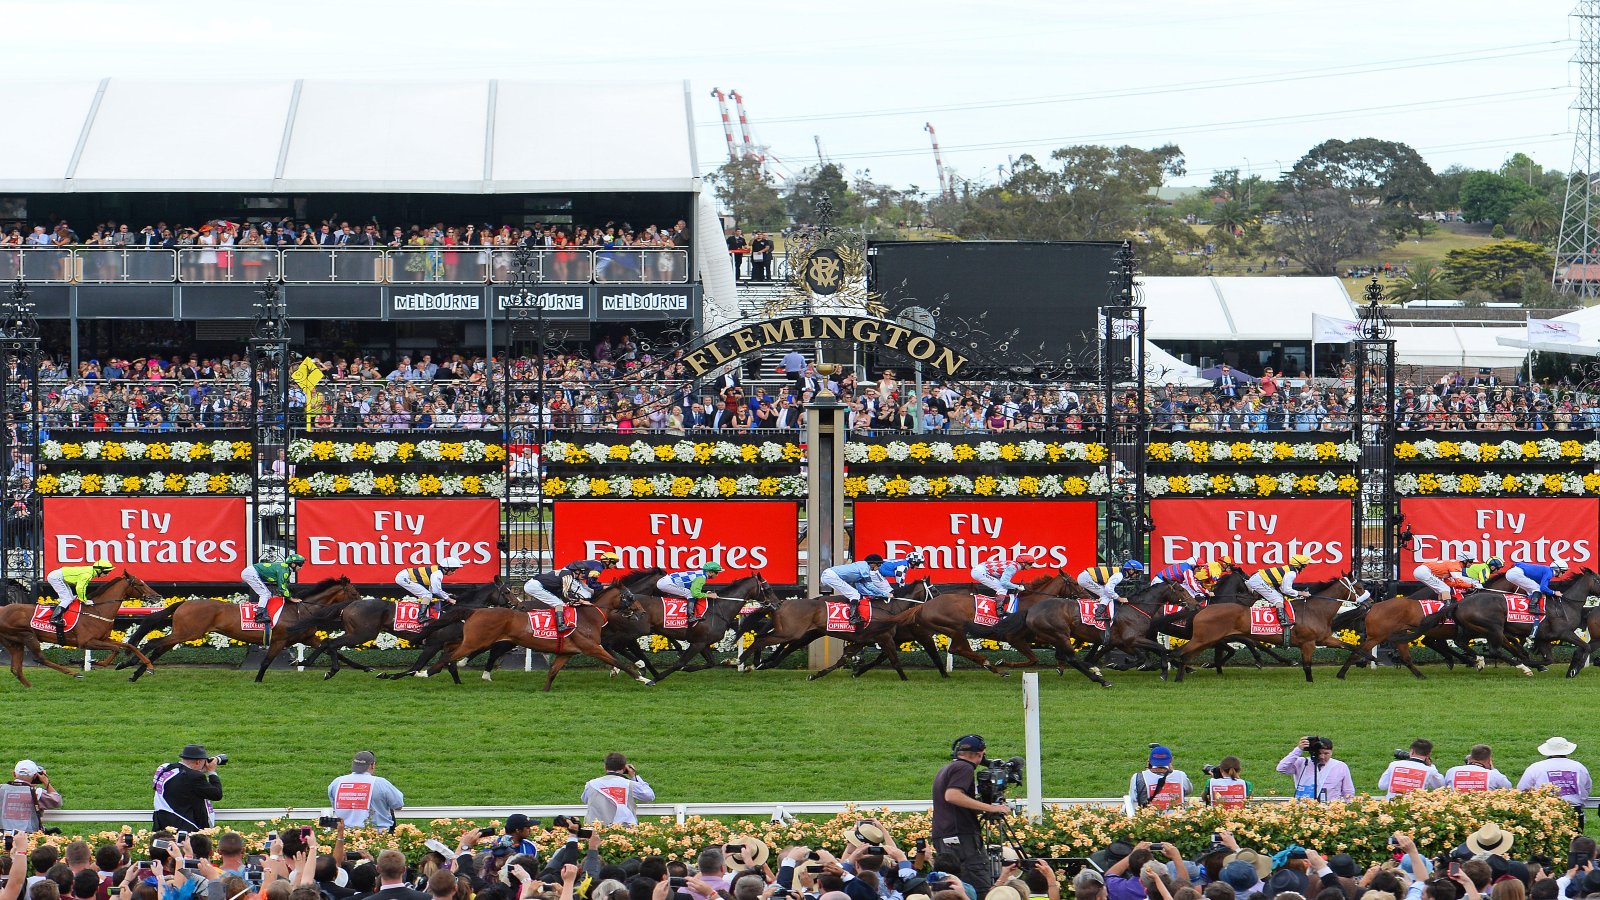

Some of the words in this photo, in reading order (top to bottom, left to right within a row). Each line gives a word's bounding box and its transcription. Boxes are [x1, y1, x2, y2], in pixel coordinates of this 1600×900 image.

[395, 294, 479, 310] MELBOURNE
[499, 294, 583, 310] MEOURNE
[603, 294, 687, 310] MELBOURNE
[683, 316, 969, 377] FLEMINGTON
[120, 509, 171, 534] Fly
[373, 510, 425, 535] Fly
[649, 513, 703, 539] Fly
[949, 513, 1003, 539] Fly
[1227, 510, 1278, 535] Fly
[1476, 509, 1526, 534] Fly
[55, 533, 238, 563] Emirates
[308, 535, 492, 565] Emirates
[1161, 534, 1343, 564] Emirates
[1412, 533, 1591, 563] Emirates
[36, 607, 50, 618] 7
[398, 606, 420, 619] 10
[666, 602, 688, 616] 24
[829, 605, 850, 619] 20
[977, 600, 990, 613] 4
[1507, 598, 1528, 611] 13
[530, 613, 552, 628] 17
[1252, 609, 1275, 623] 16
